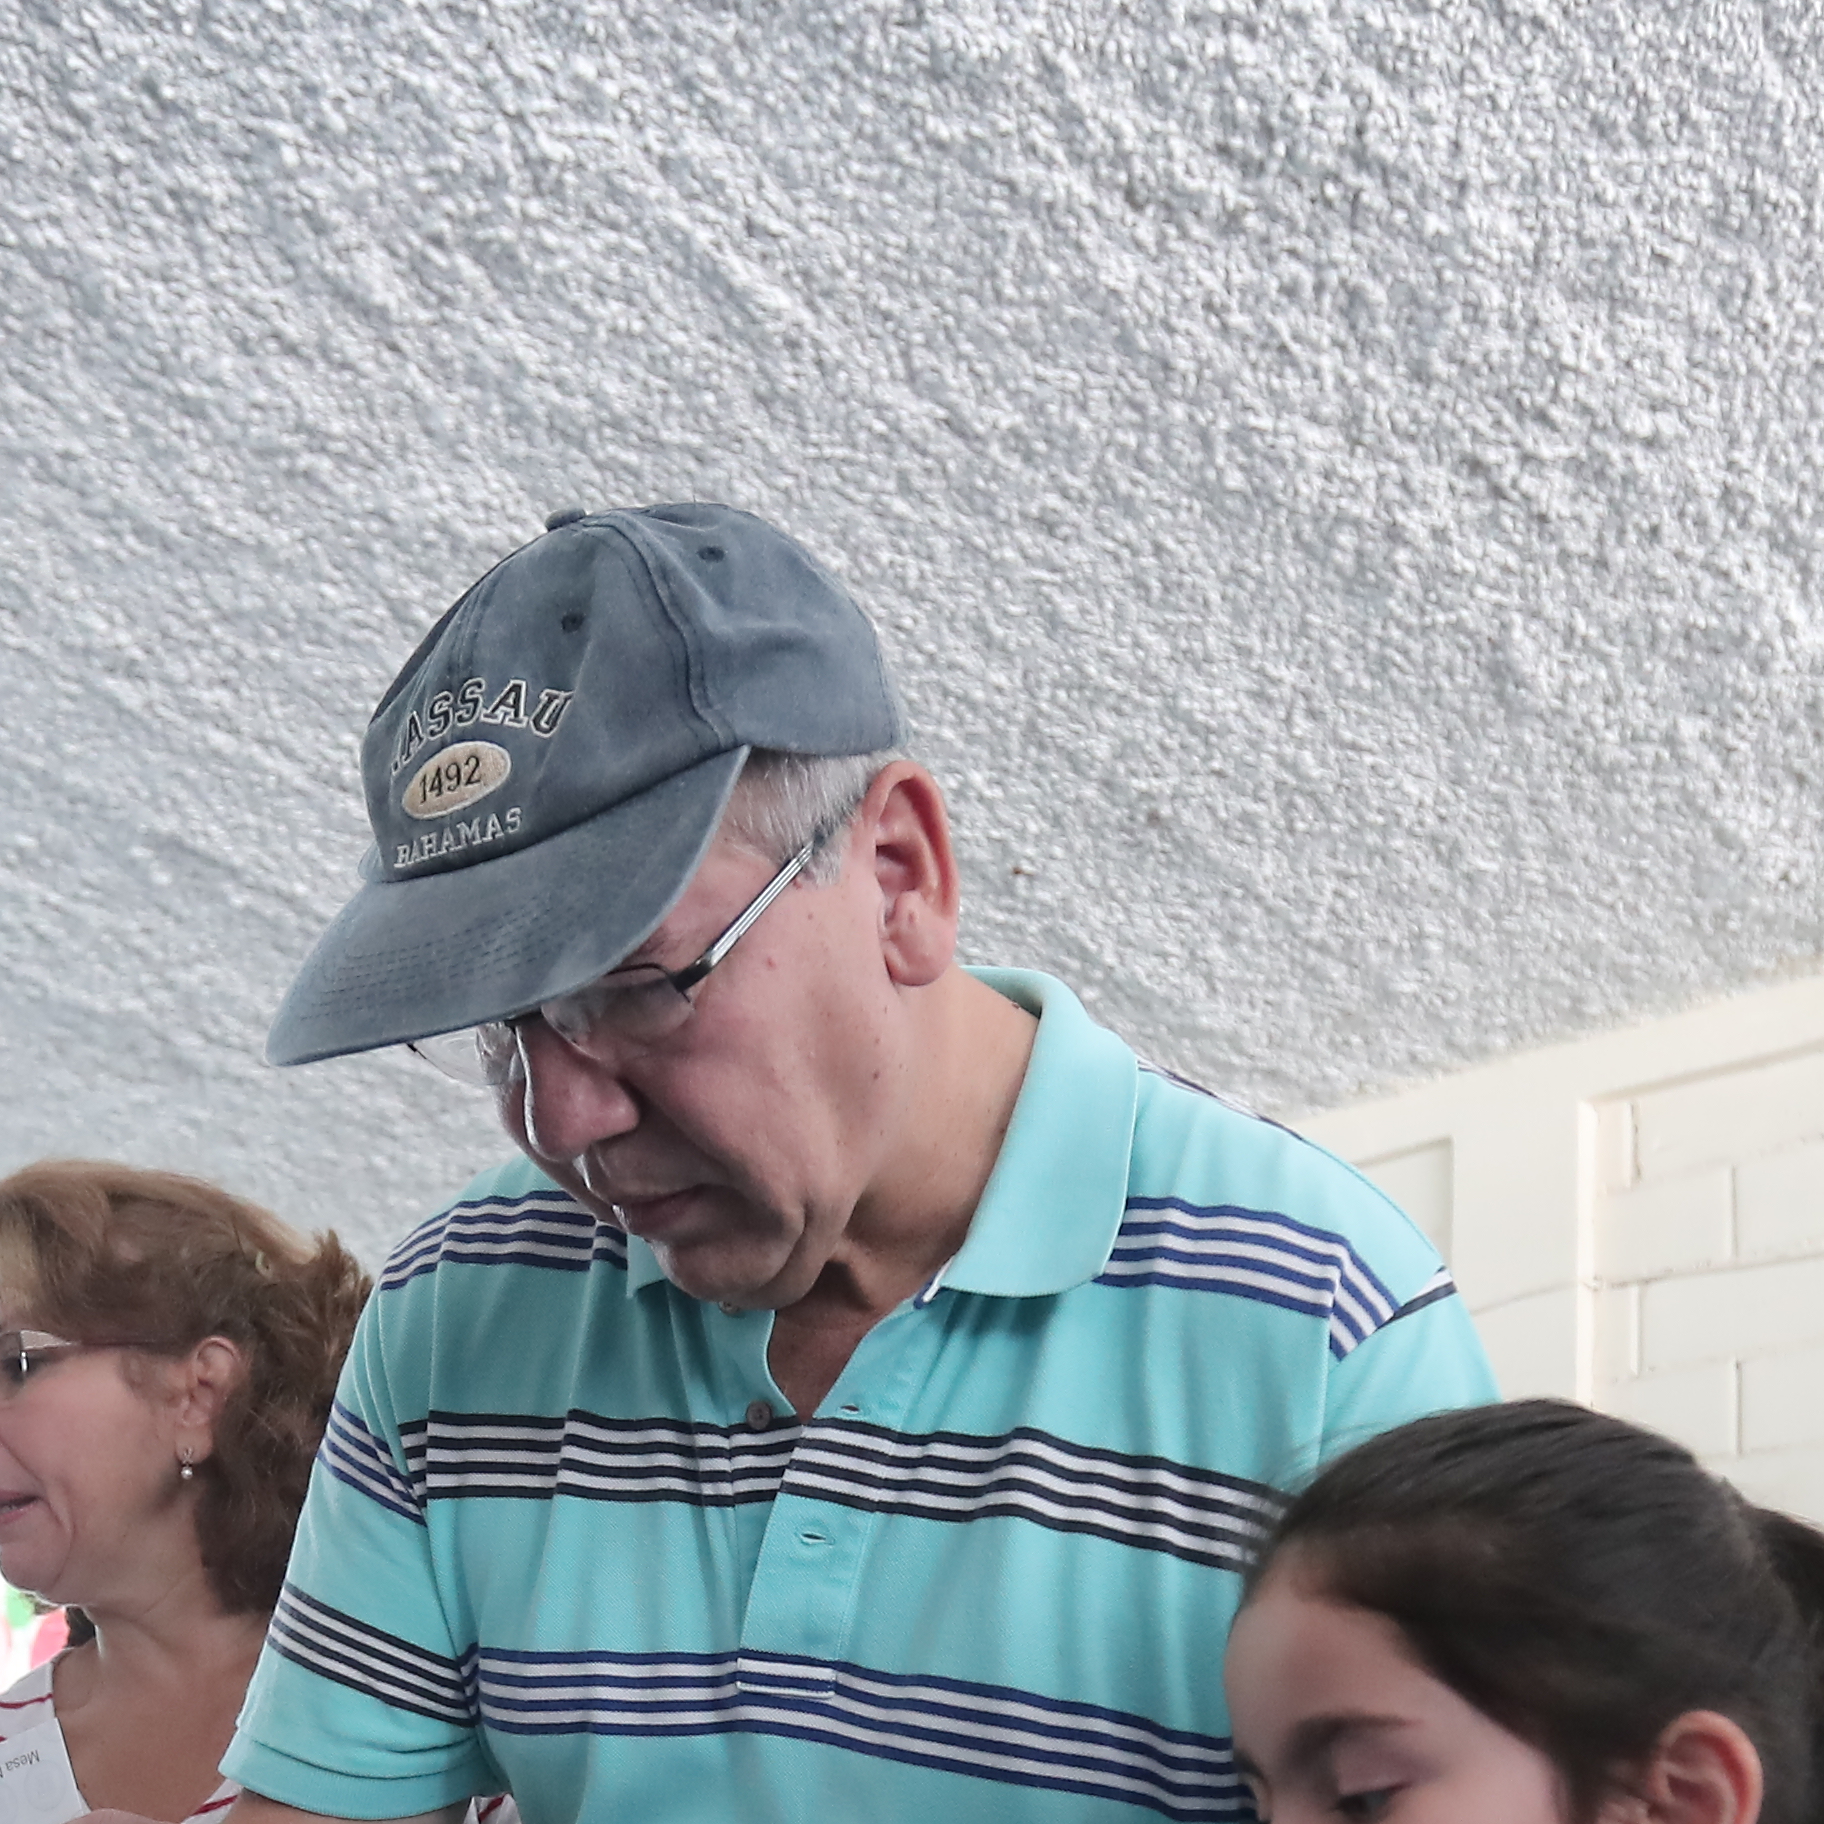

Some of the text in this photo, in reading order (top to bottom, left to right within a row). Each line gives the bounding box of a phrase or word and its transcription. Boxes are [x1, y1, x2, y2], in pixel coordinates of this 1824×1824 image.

[391, 676, 575, 776] ASSAU
[419, 754, 482, 804] 1492
[393, 806, 524, 869] BAHAMAS
